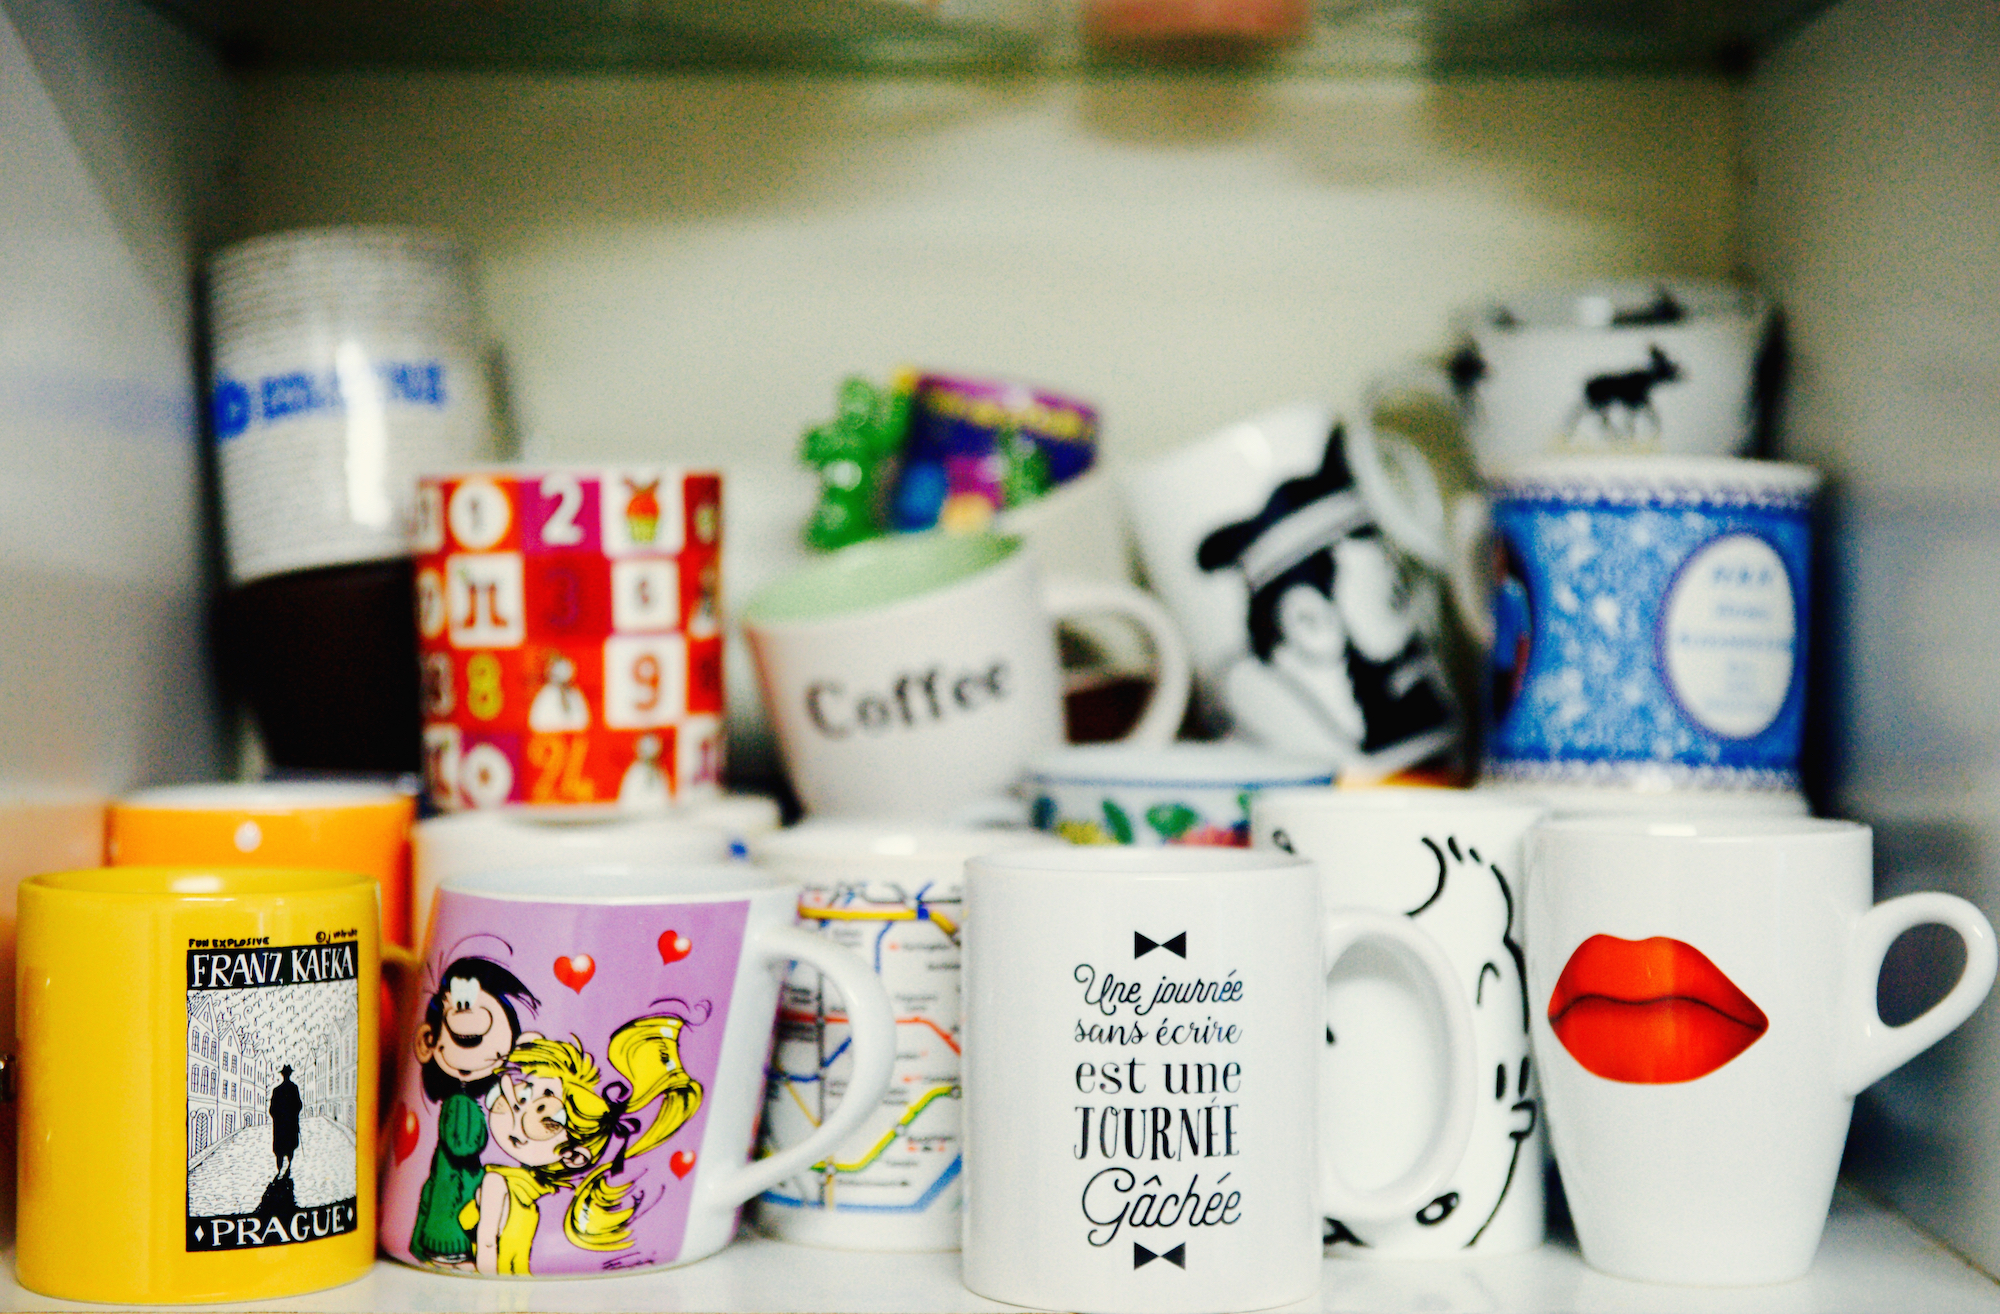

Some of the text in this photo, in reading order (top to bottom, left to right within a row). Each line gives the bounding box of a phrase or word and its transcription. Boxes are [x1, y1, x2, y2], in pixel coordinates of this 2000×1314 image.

[539, 474, 586, 547] 2
[466, 652, 504, 723] 8
[632, 652, 661, 714] 9
[805, 659, 1011, 740] Coffee
[189, 936, 270, 948] FUN EXPLOSIVE
[191, 945, 355, 988] FRANZ KAFKA
[1074, 963, 1243, 1015] Une journée
[1074, 1016, 1243, 1046] sans écrire
[1075, 1057, 1242, 1094] est une
[1073, 1096, 1240, 1161] JOURNÉE
[211, 1205, 346, 1247] PRAGUE
[1082, 1166, 1242, 1247] Gâchée
